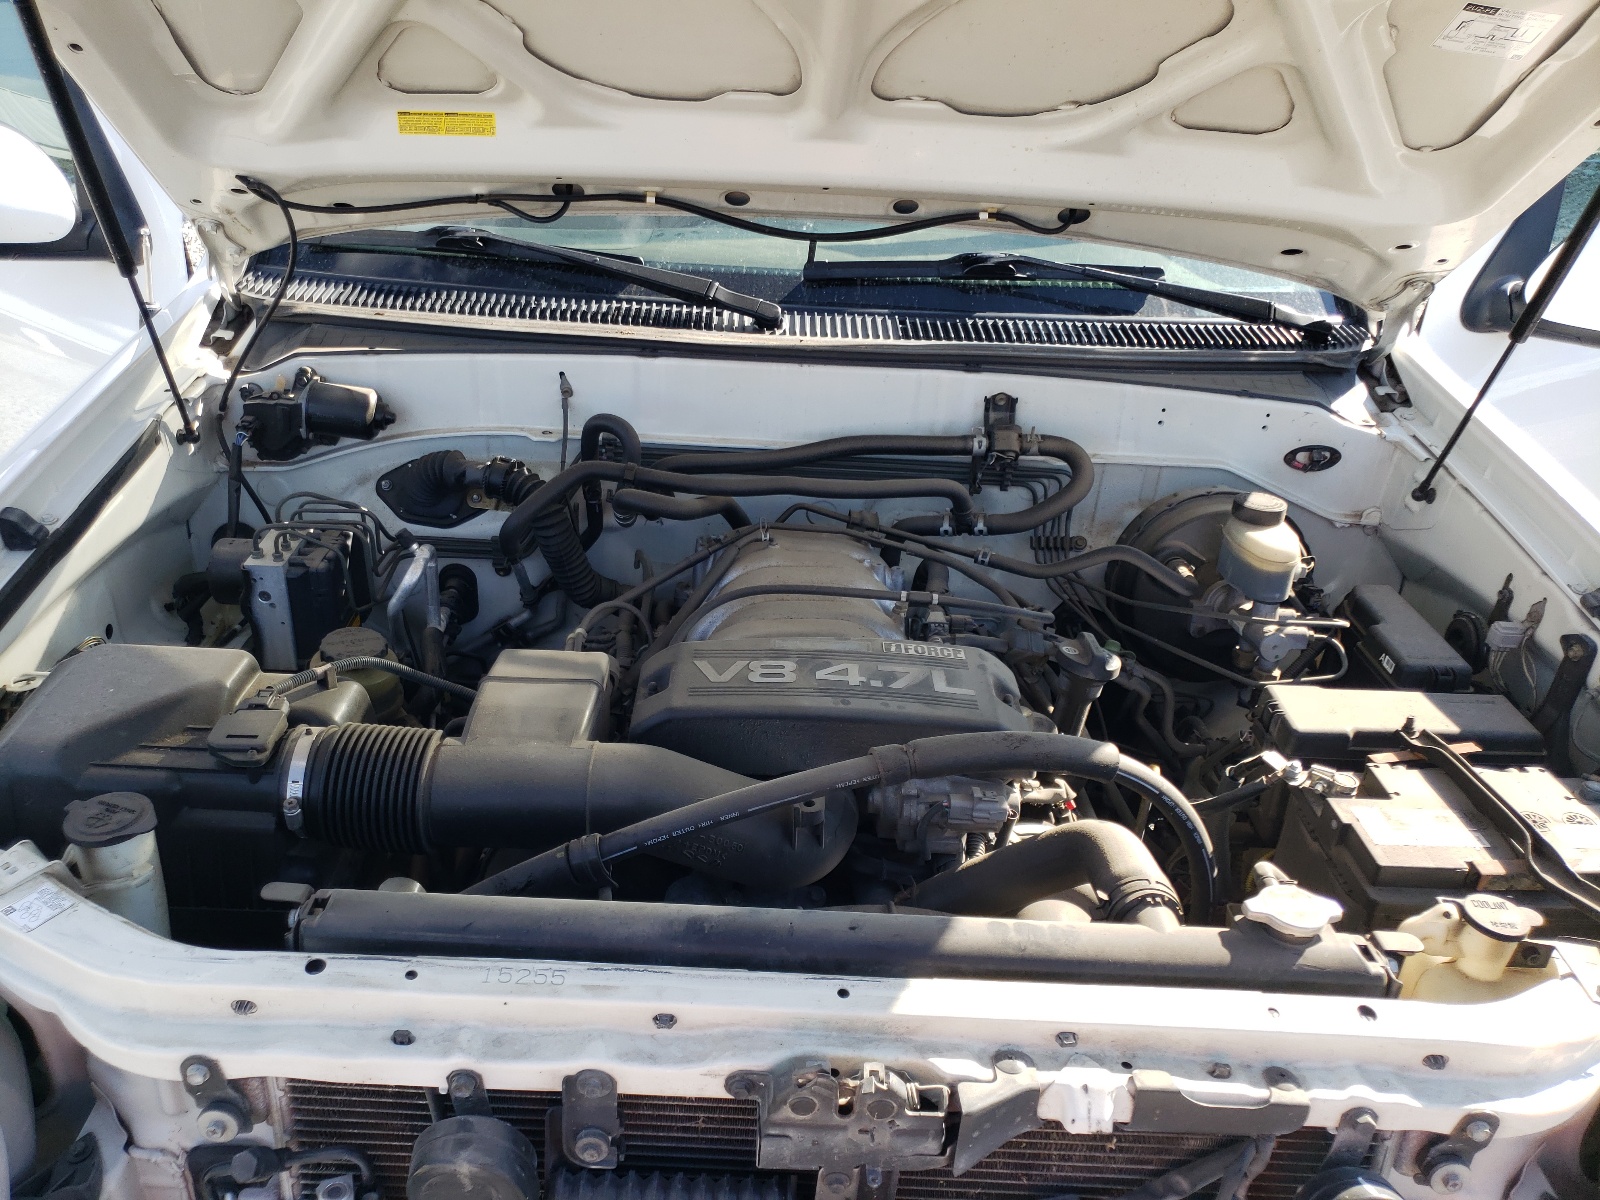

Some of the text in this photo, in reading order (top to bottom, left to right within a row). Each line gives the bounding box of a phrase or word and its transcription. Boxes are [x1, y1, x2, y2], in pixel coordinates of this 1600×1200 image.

[693, 660, 976, 696] V8 4.7L
[482, 966, 567, 986] 15255
